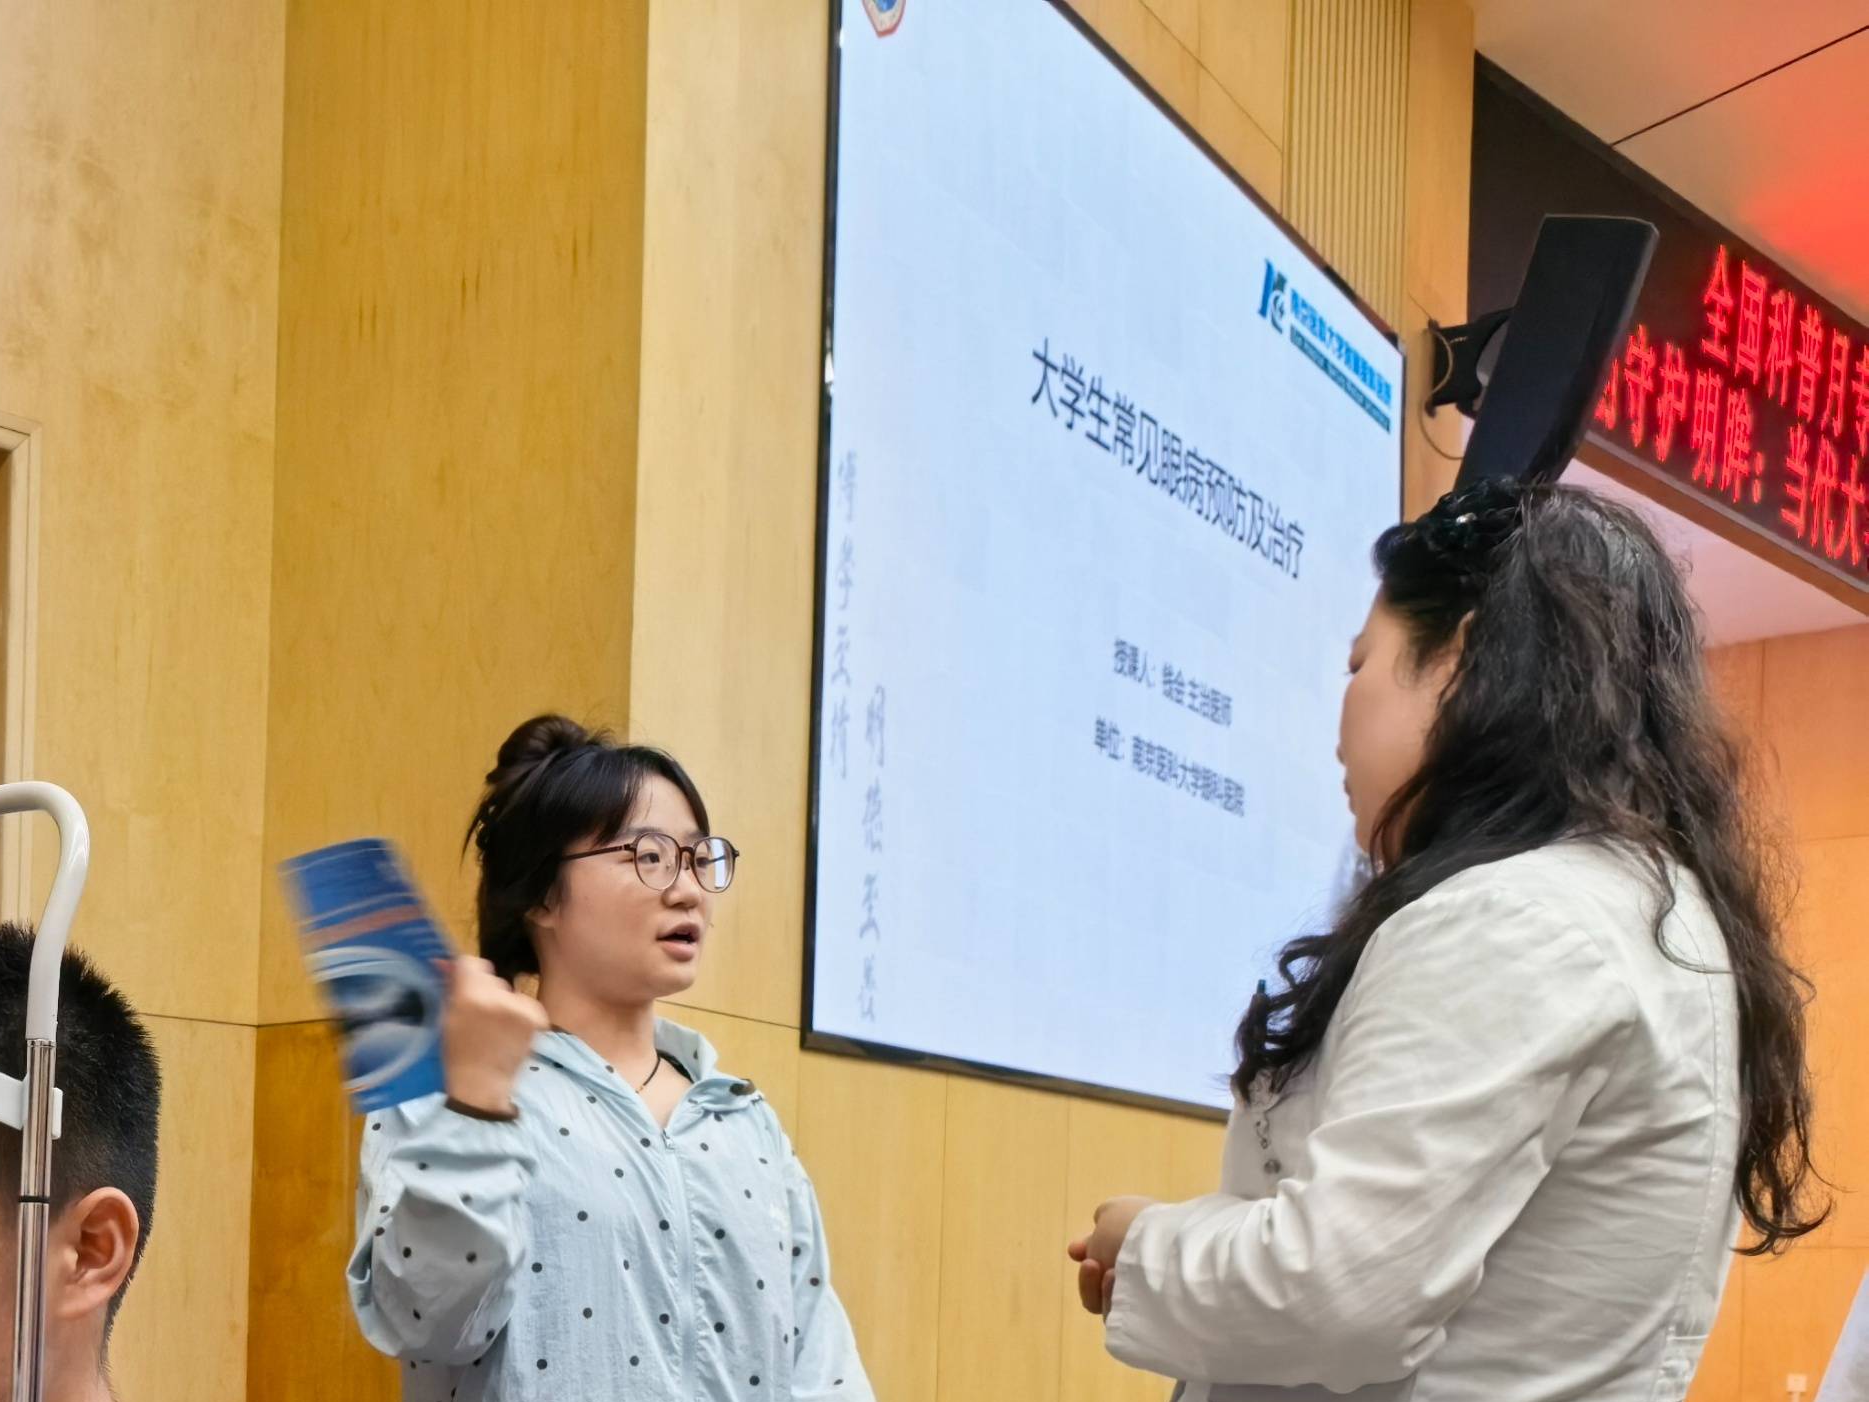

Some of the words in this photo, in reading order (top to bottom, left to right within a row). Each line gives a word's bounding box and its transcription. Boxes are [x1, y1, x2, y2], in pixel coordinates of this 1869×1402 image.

[1031, 336, 1305, 580] 大学生常见眼病预防及治疗
[1596, 324, 1869, 566] 守护明眸：当代大
